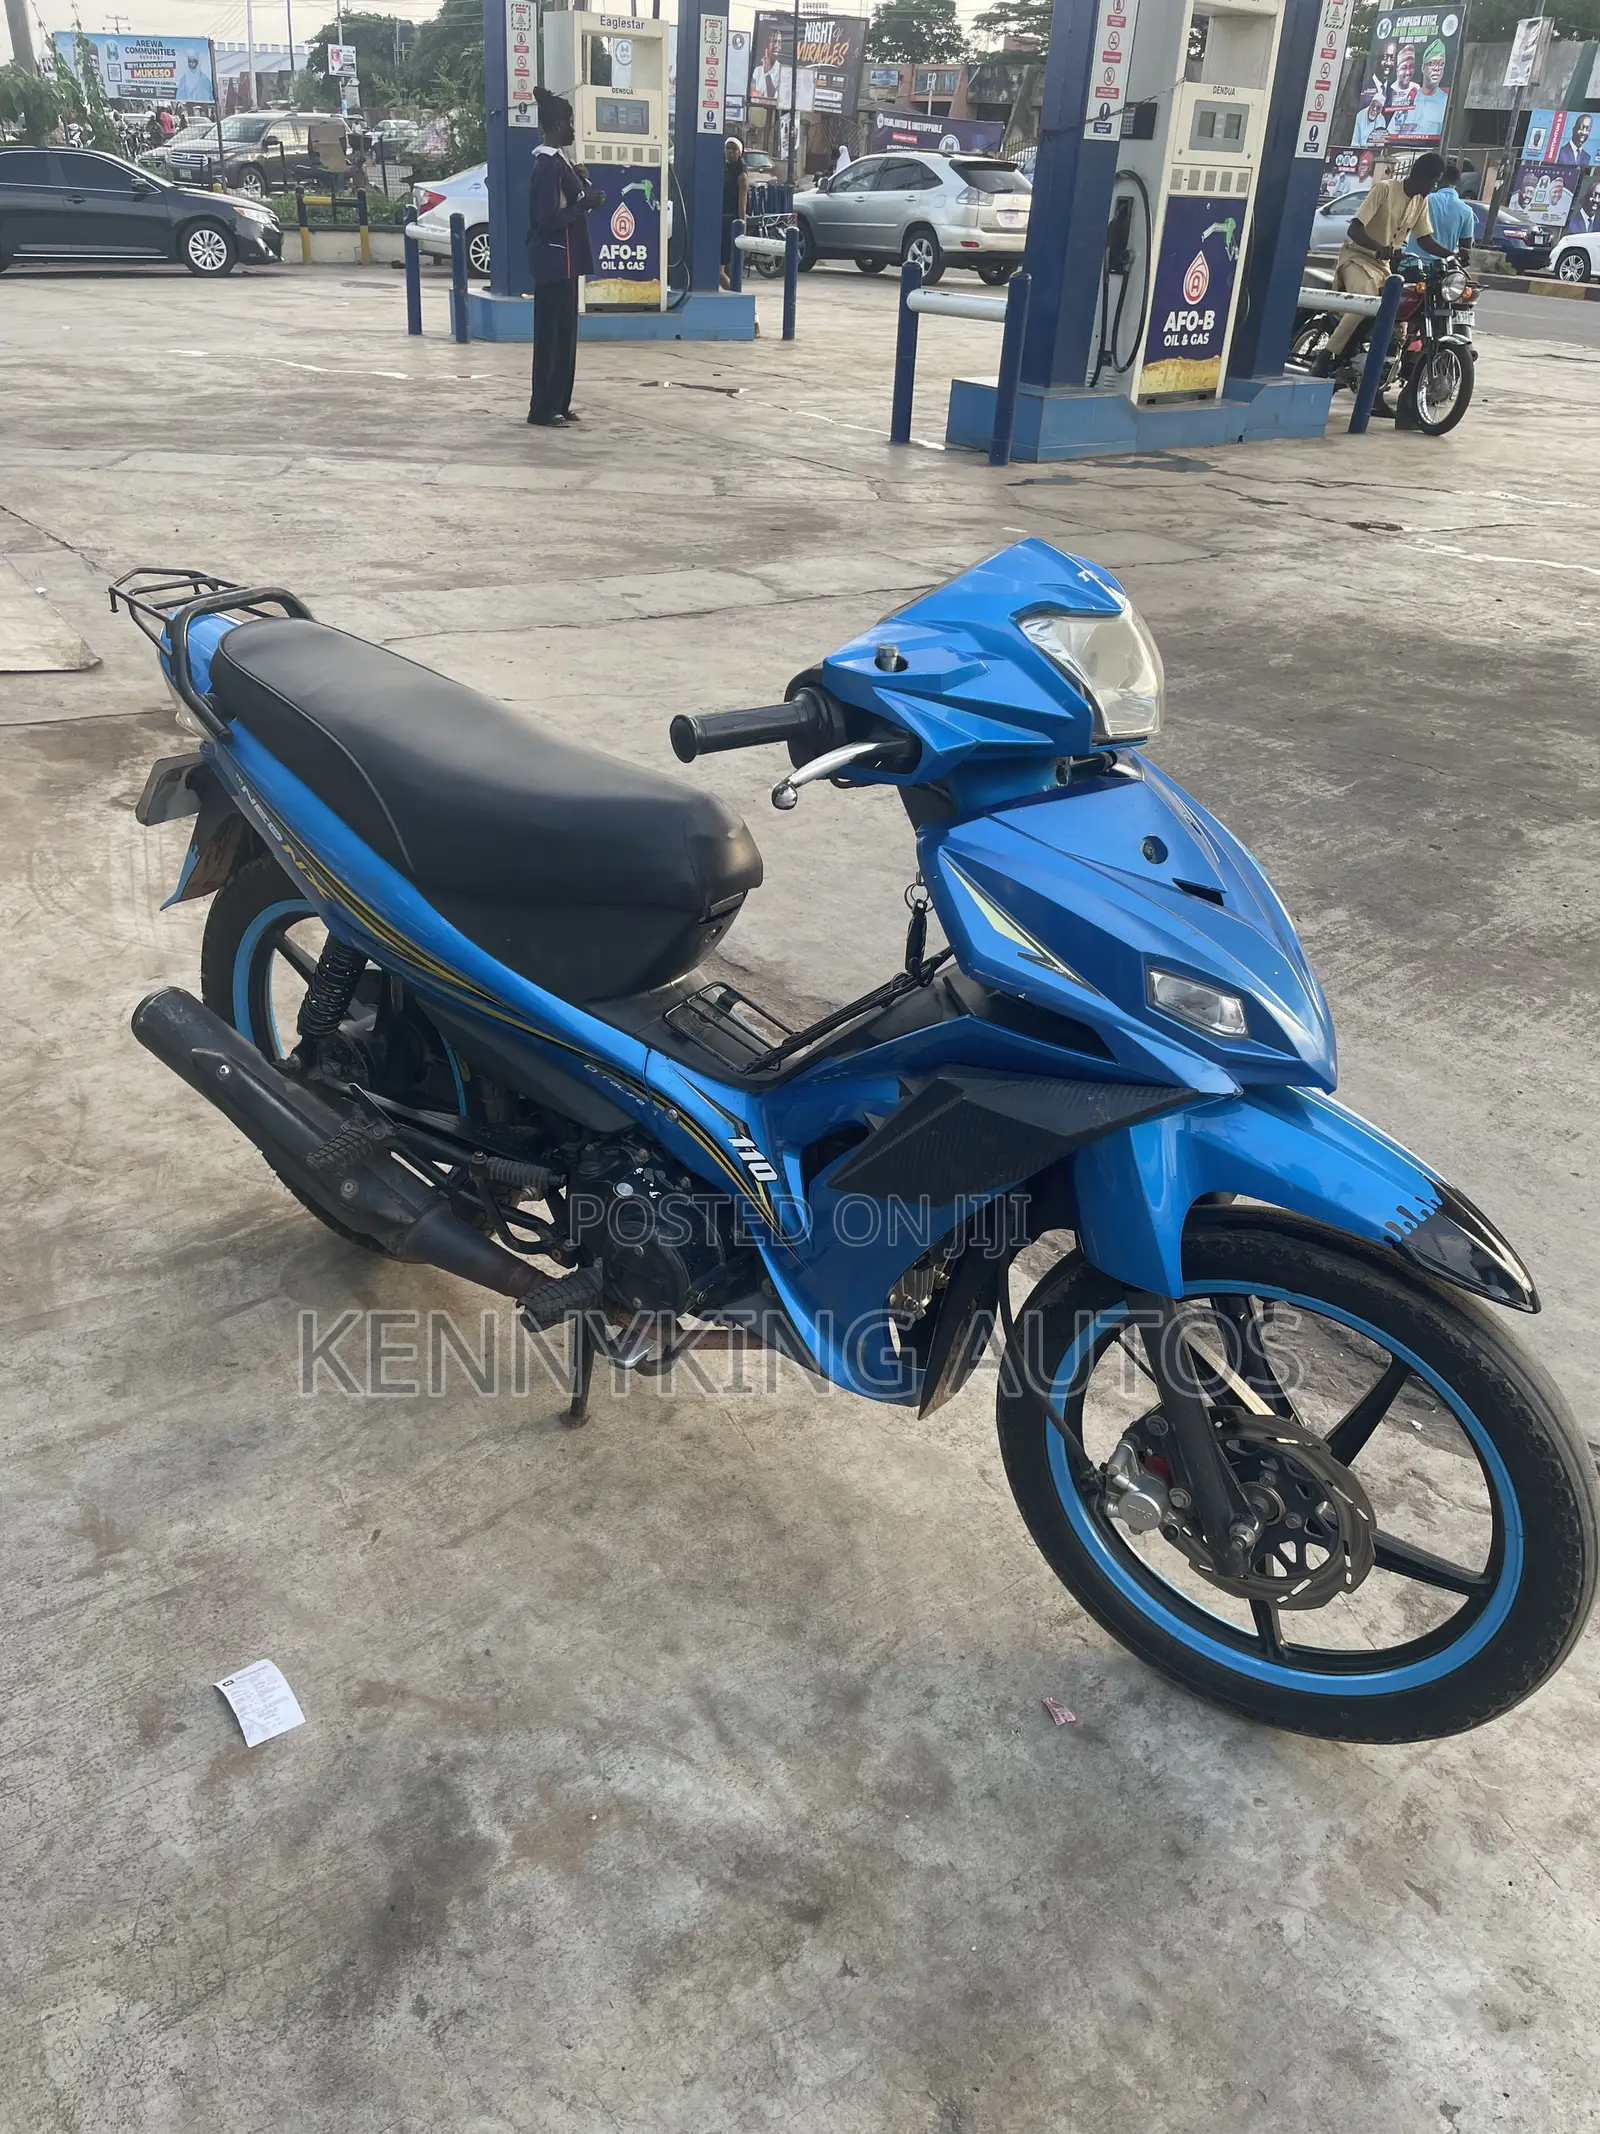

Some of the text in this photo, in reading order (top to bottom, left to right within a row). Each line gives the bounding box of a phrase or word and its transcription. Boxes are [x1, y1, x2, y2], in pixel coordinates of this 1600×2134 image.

[600, 15, 645, 29] Eaglestar
[804, 21, 835, 43] NIGHT
[124, 46, 176, 56] COMMUNITIES
[135, 39, 163, 48] AREWA
[797, 37, 850, 65] MIRACLES
[133, 69, 171, 78] MUKESO
[599, 244, 648, 260] AFO-B
[601, 261, 645, 271] OIL & GAS
[1163, 310, 1216, 332] AFO-B
[1164, 332, 1210, 347] OIL & GAS
[241, 785, 283, 842] NEO
